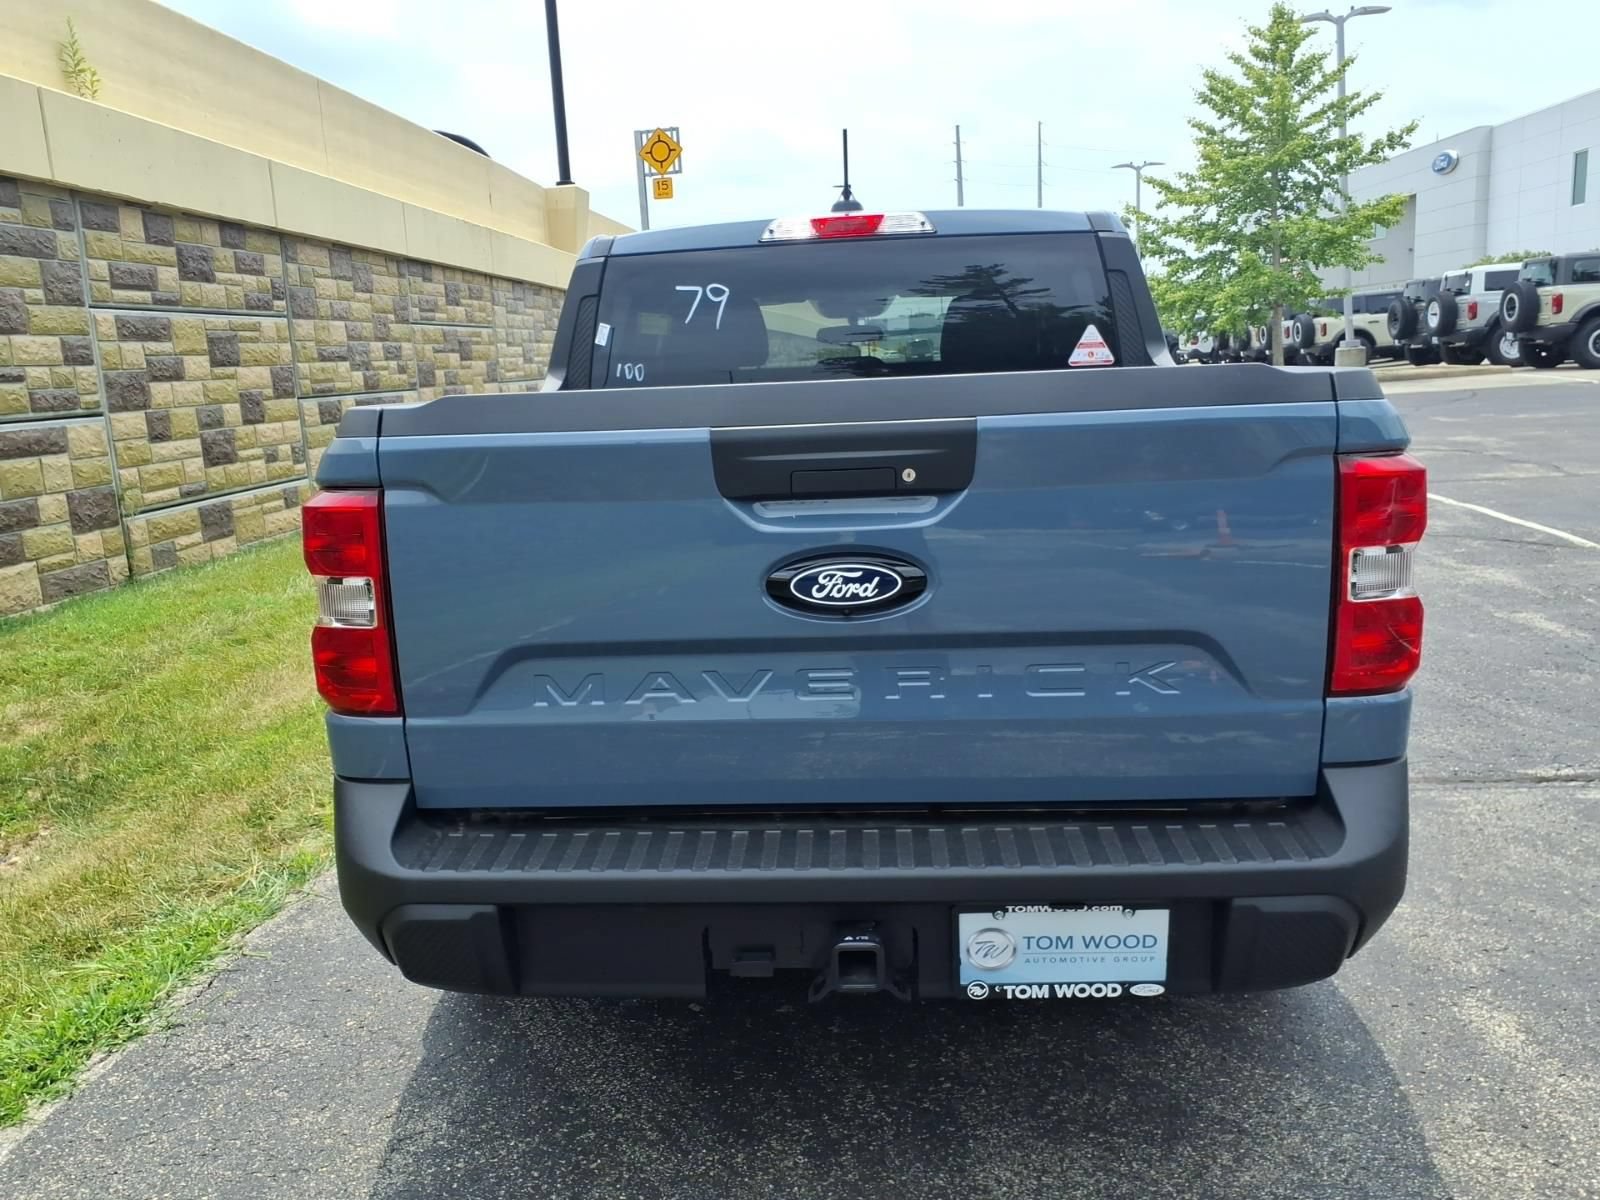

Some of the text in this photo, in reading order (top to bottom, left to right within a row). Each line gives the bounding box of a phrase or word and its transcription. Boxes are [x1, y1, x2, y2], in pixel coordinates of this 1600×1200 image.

[656, 180, 669, 191] 15
[674, 283, 730, 330] 79
[615, 362, 645, 382] 100
[811, 570, 880, 599] Ford
[532, 659, 1181, 708] MAVERICK
[1005, 905, 1123, 913] TOMW.com
[1023, 934, 1158, 950] TOM WOOD
[1024, 955, 1156, 964] AUTOMOTIVE GROUP
[1053, 983, 1123, 998] WOOD
